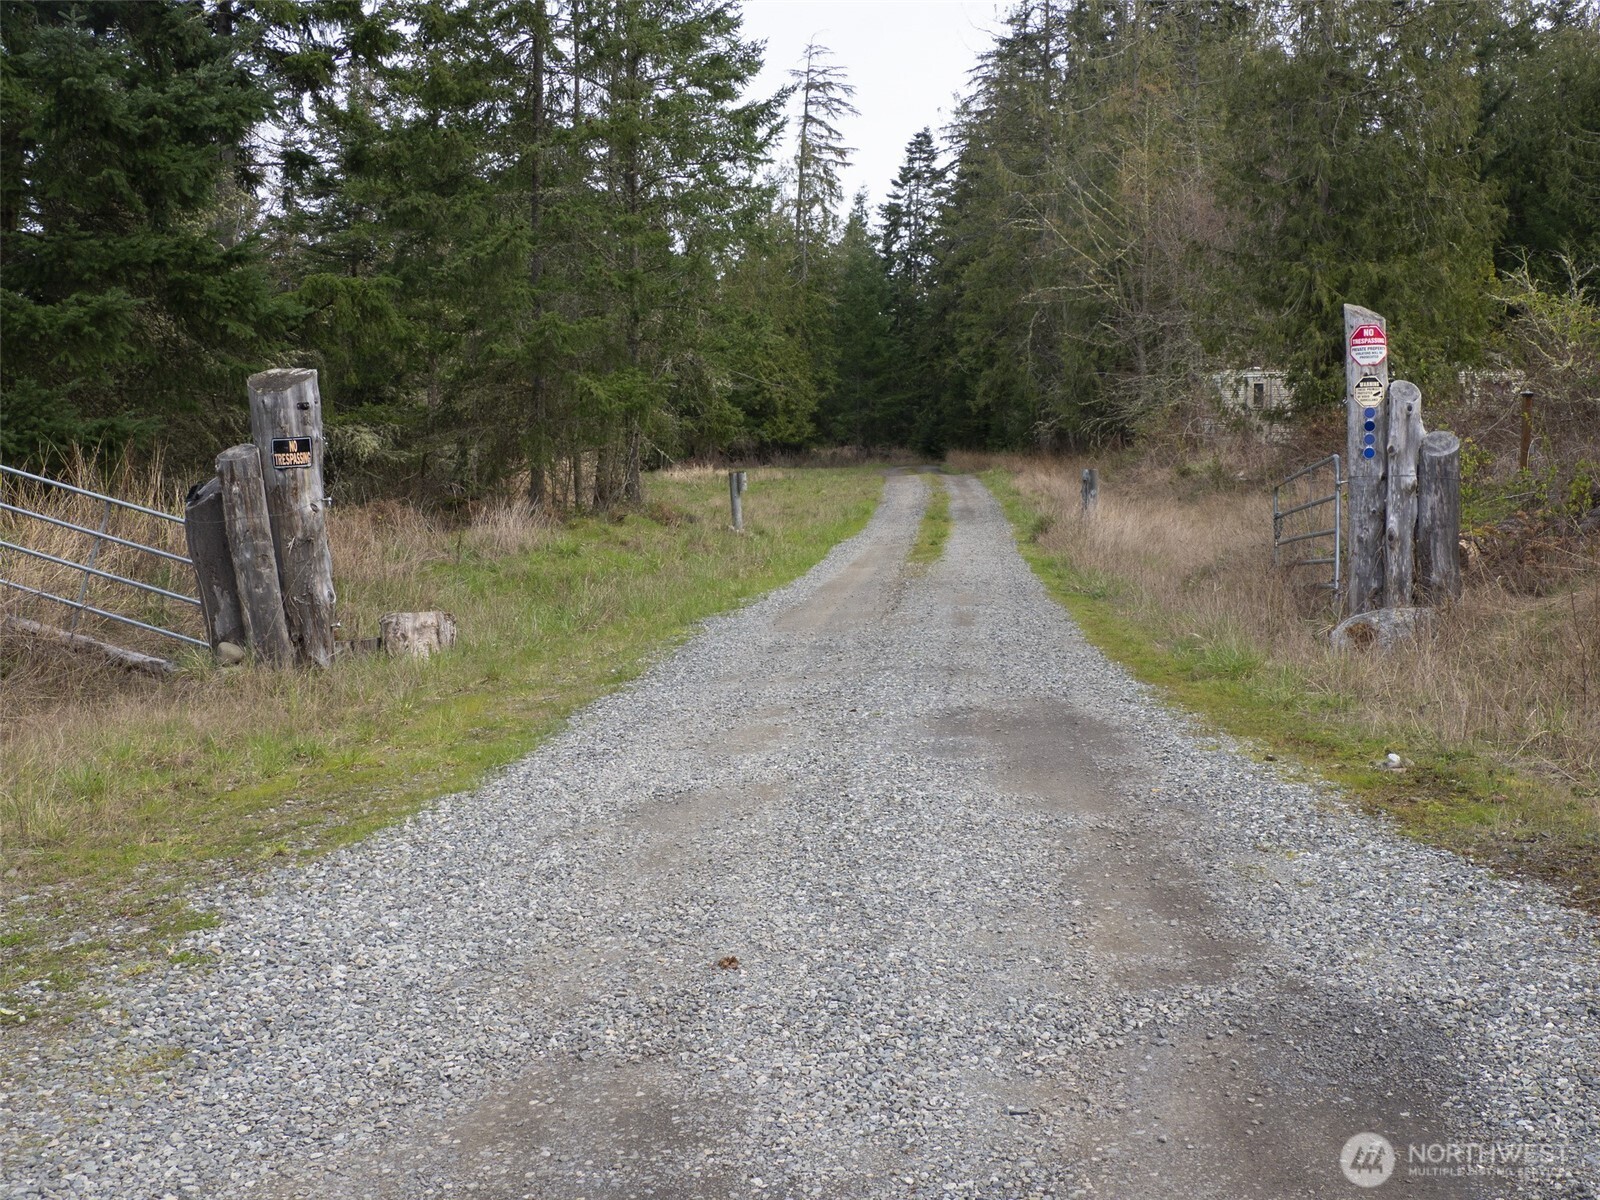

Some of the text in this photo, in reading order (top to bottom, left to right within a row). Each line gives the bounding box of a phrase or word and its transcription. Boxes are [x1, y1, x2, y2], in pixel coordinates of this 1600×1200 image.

[1363, 328, 1374, 336] NO
[289, 440, 298, 452] NO
[274, 452, 310, 466] TRESPASSING
